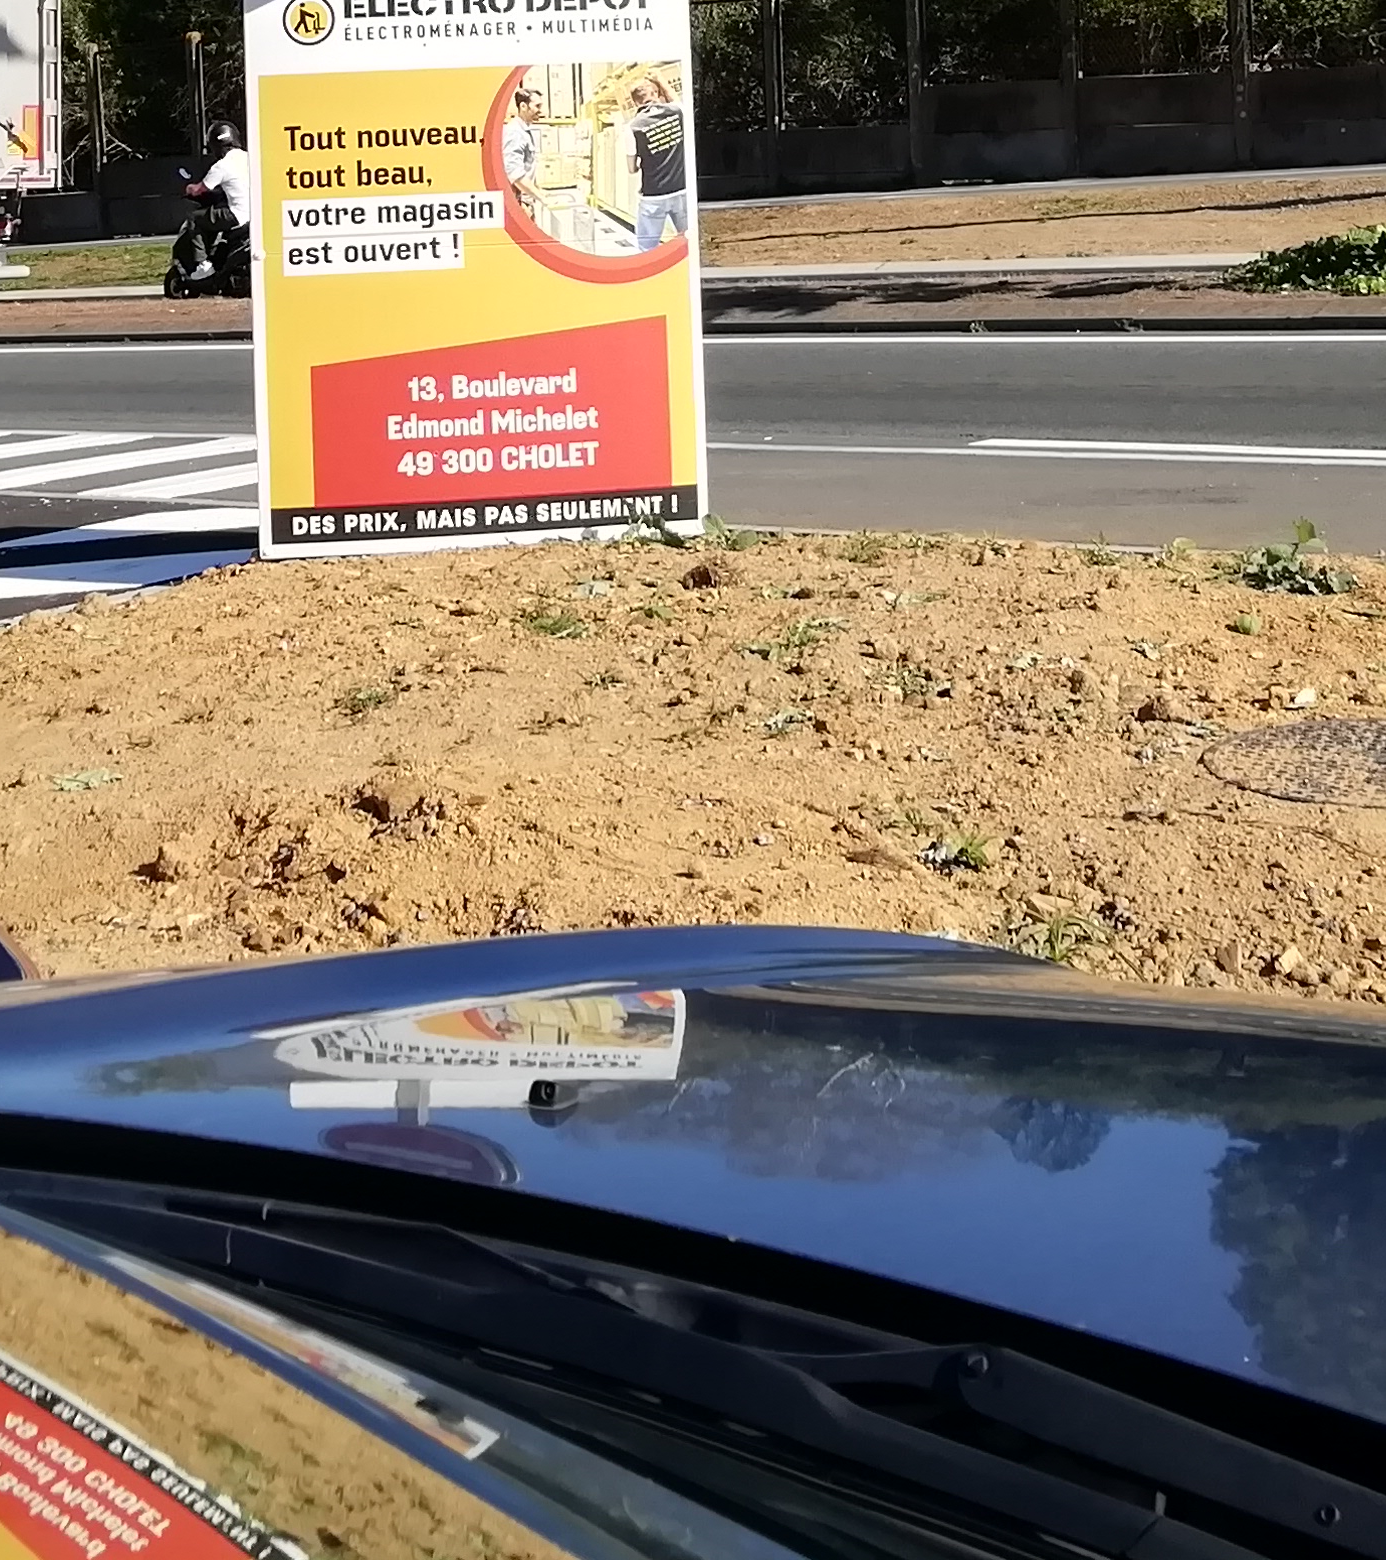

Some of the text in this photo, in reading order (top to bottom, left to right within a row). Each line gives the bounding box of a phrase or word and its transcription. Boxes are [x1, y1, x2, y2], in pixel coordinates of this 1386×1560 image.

[343, 13, 654, 41] ÉLECTROMÉNAGER MULTIMÉDIA
[284, 125, 485, 152] Tout nouveau,
[285, 159, 433, 189] tout beau,
[287, 194, 494, 228] votre magasin
[287, 232, 459, 266] est ouvert !
[408, 367, 577, 403] 13, Boulevard
[386, 404, 599, 440] Edmond Michelet
[397, 441, 600, 476] 49 300 CHOLET
[291, 516, 337, 536] DES
[344, 513, 407, 534] PRIX,
[417, 507, 476, 530] MAIS
[485, 504, 530, 526] PAS
[670, 493, 679, 514] !
